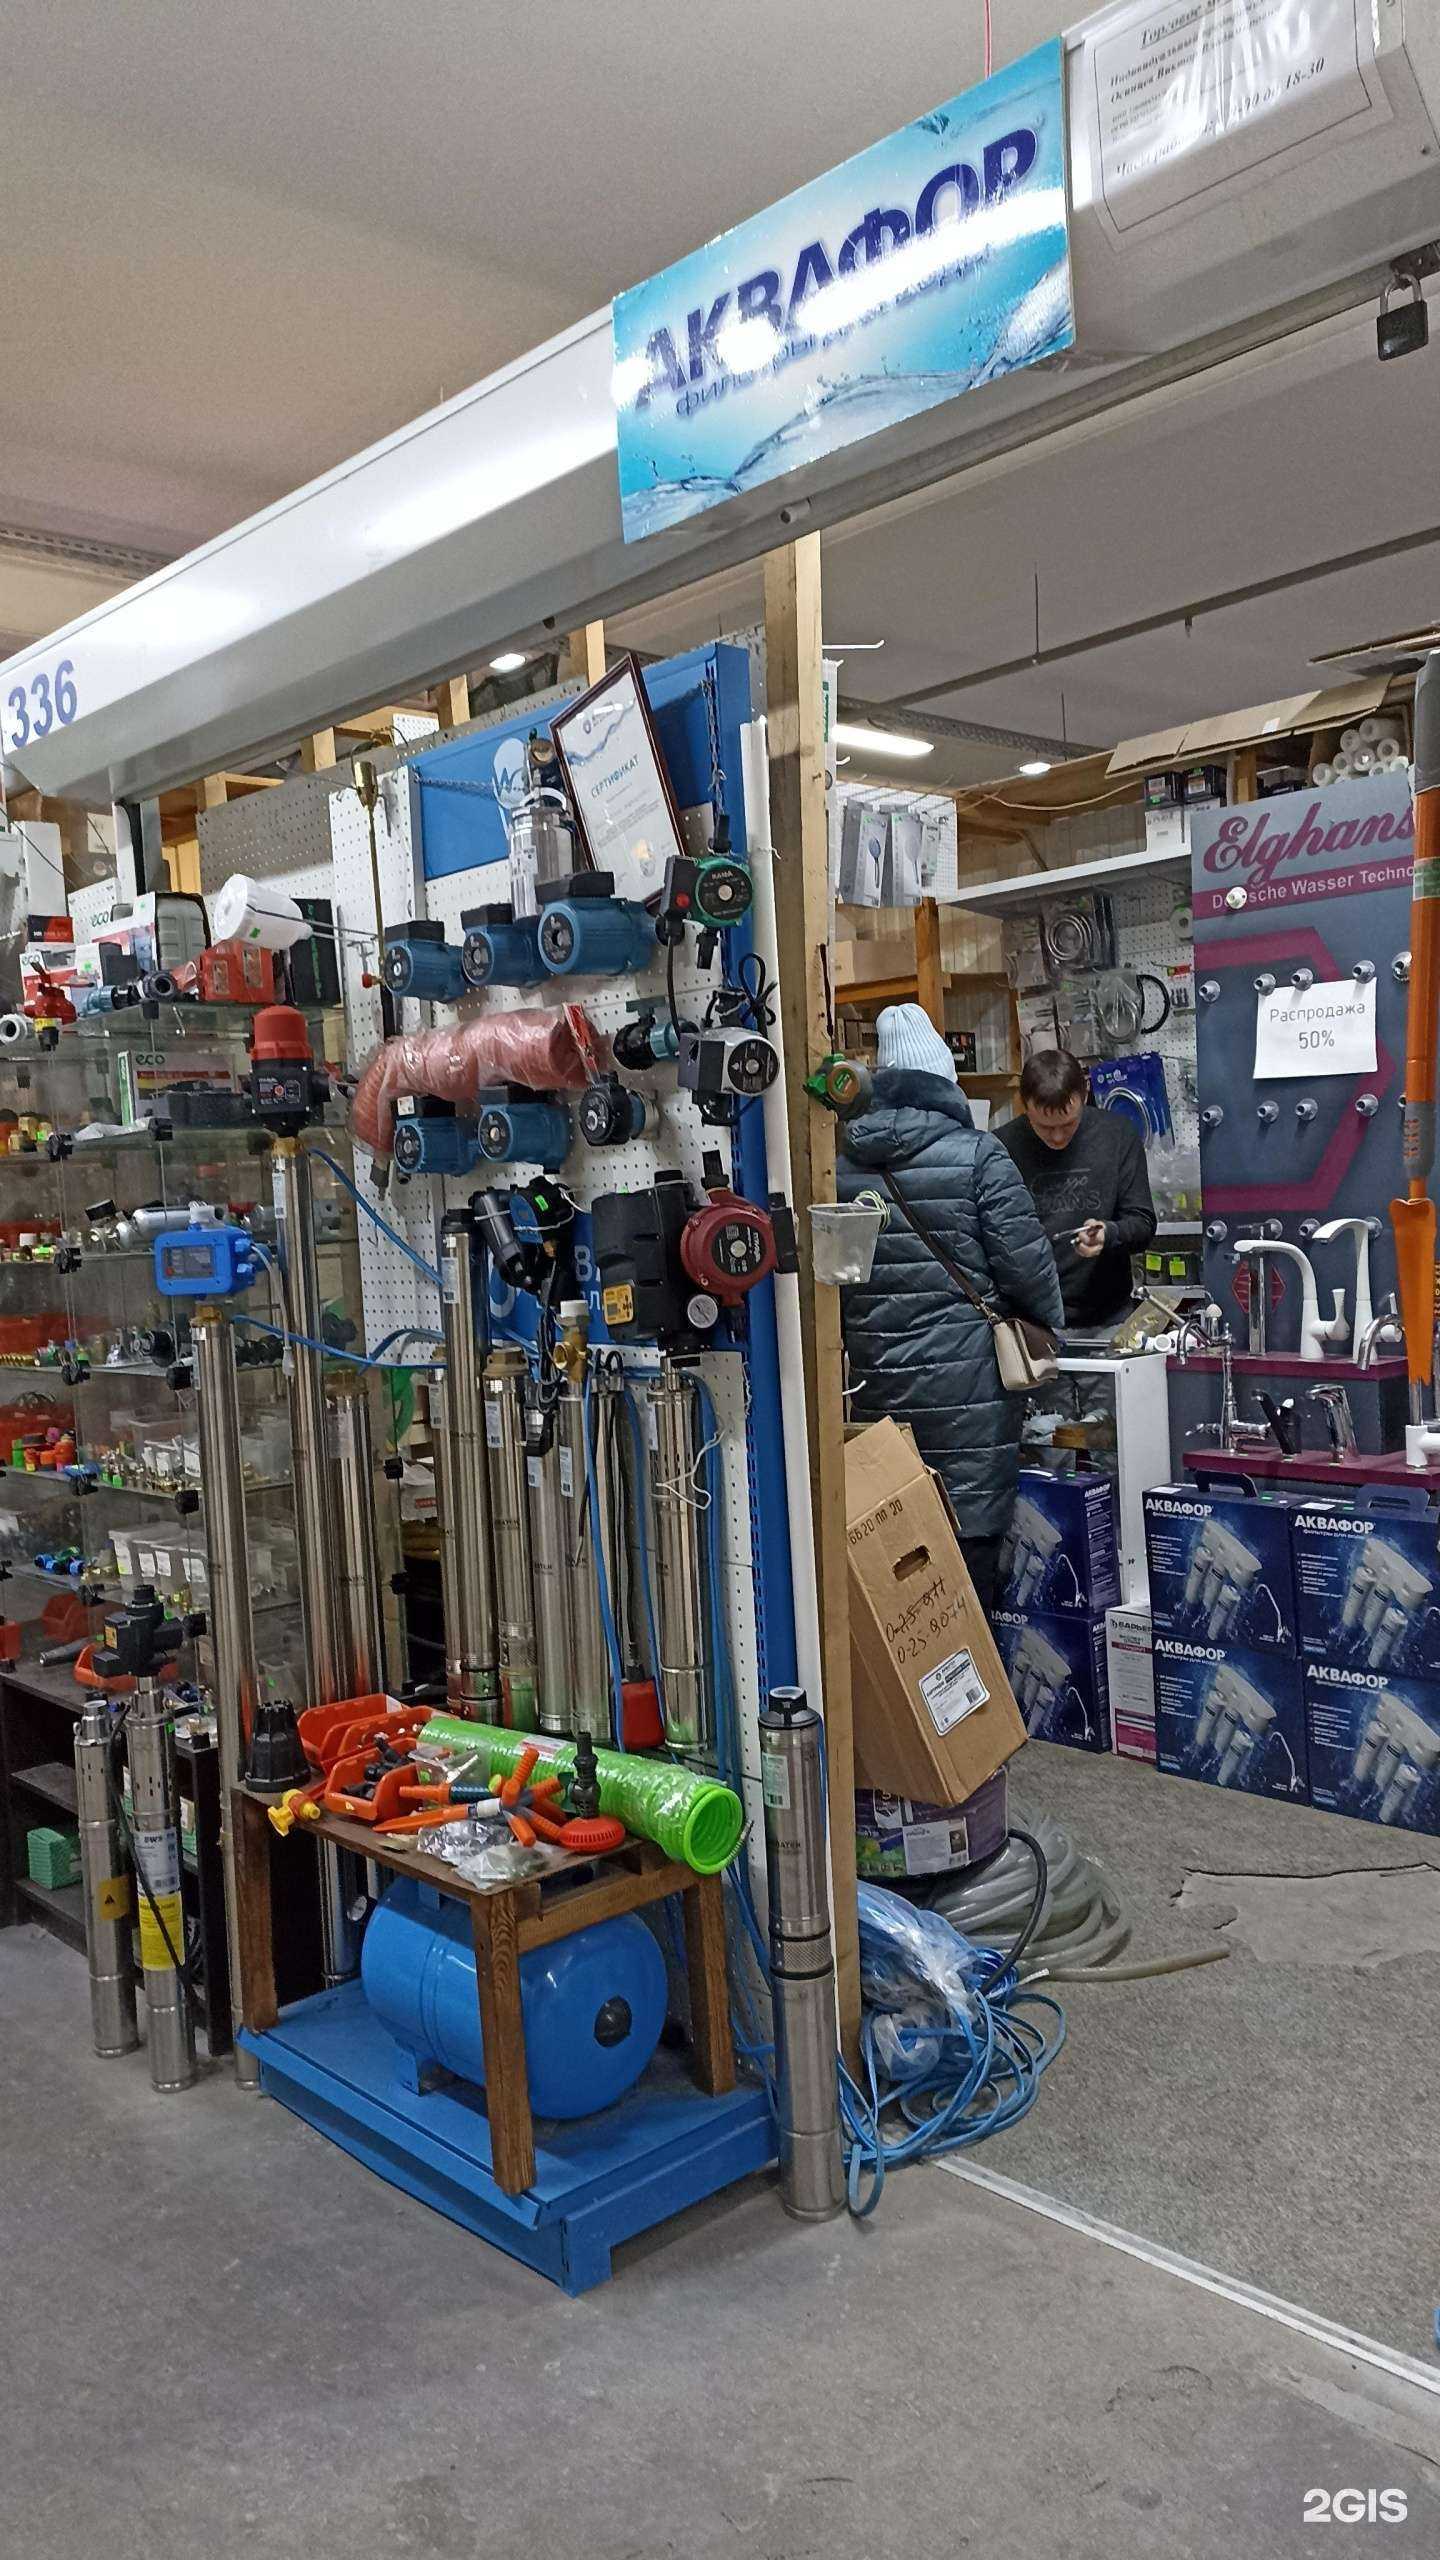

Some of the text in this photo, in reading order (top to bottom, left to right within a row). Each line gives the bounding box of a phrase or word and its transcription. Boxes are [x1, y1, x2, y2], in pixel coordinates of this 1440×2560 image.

[1286, 56, 1326, 89] 18-30
[8, 659, 78, 748] 336
[590, 753, 641, 799] СЕРТИФИКАТ
[1203, 801, 1415, 889] Elghans
[1212, 885, 1287, 909] Dsche
[1291, 867, 1355, 895] Wasser
[1269, 1001, 1366, 1023] Распродажа
[1298, 1030, 1335, 1050] 50%
[135, 1054, 166, 1066] eco
[890, 1498, 904, 1515] 20
[1145, 1498, 1213, 1517] АКВАФОР
[1294, 1514, 1375, 1534] АКВАФОР
[1154, 1639, 1226, 1661] АКВАФОР
[1307, 1664, 1389, 1689] АКВАФОР
